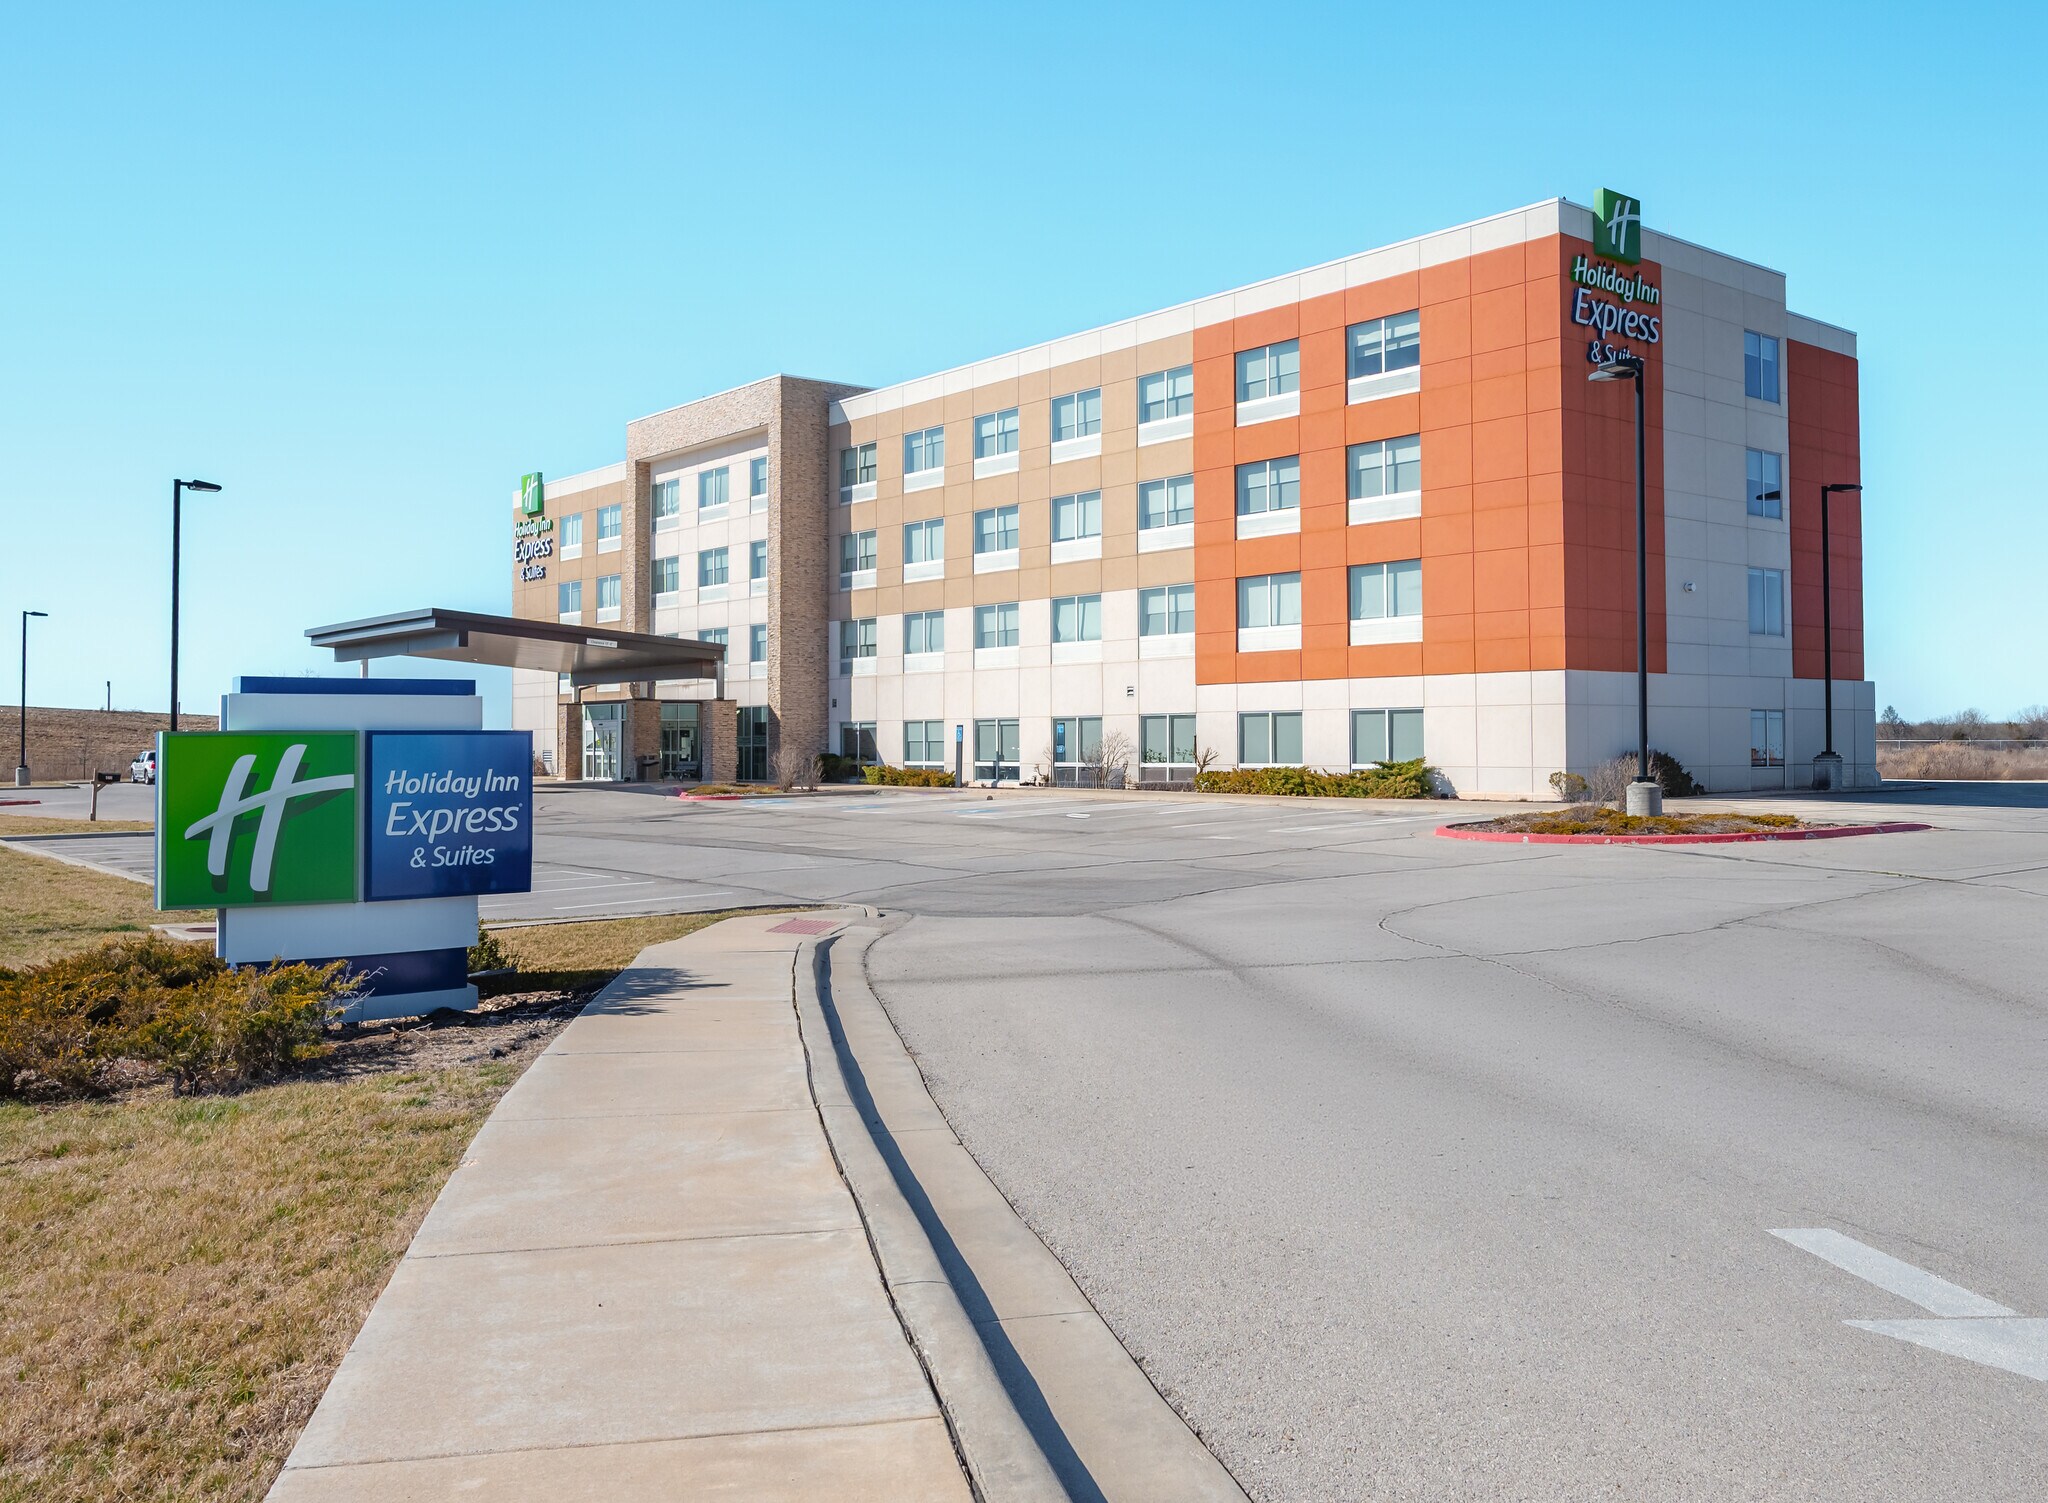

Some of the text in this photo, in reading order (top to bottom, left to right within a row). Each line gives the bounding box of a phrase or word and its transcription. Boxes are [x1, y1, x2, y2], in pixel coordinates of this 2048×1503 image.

[1574, 256, 1660, 304] Holiday Inn
[1575, 287, 1660, 343] Express
[1591, 340, 1602, 363] &
[515, 516, 551, 537] Holiday Inn
[515, 538, 551, 564] Express
[526, 565, 544, 579] Suites
[385, 768, 520, 798] Holiday Inn
[386, 801, 520, 844] Express
[410, 845, 496, 868] & Suites
